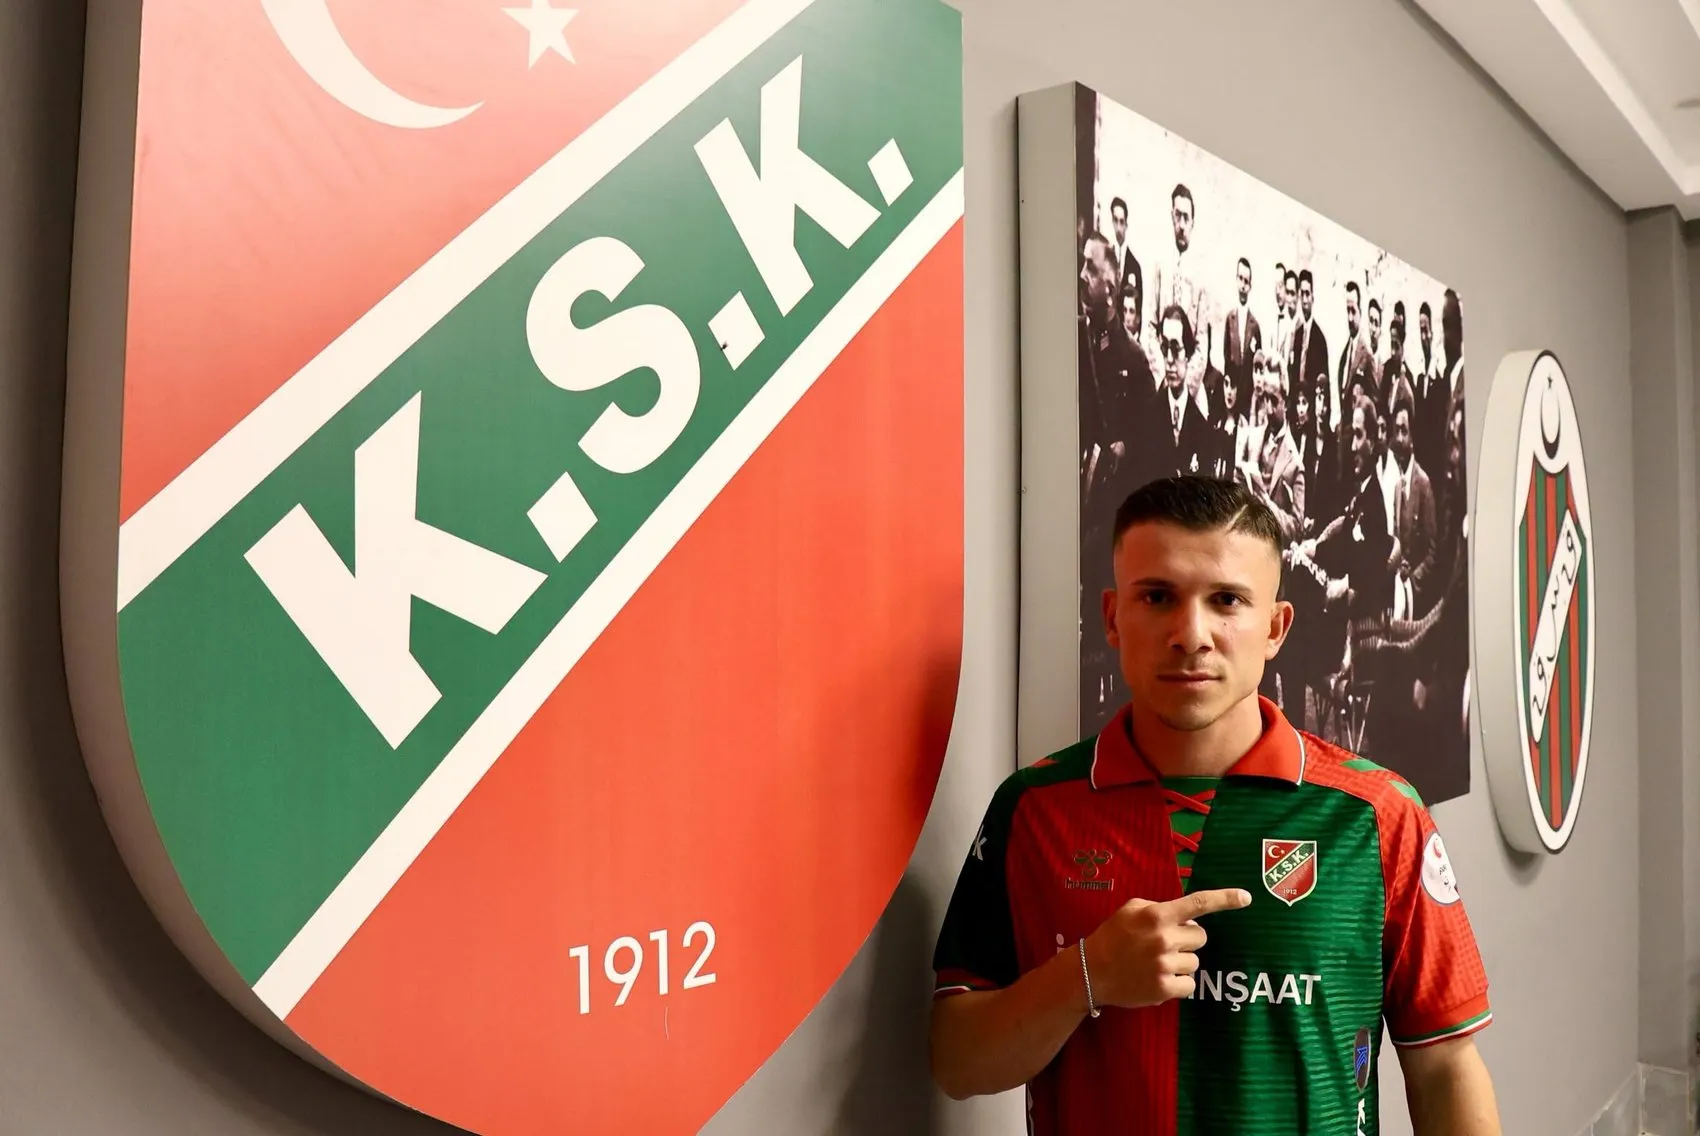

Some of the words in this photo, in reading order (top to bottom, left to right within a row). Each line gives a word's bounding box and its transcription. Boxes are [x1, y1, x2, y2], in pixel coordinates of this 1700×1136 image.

[243, 54, 913, 750] K.S.K.
[1269, 850, 1309, 882] K.S.K.
[569, 921, 716, 1014] 1912
